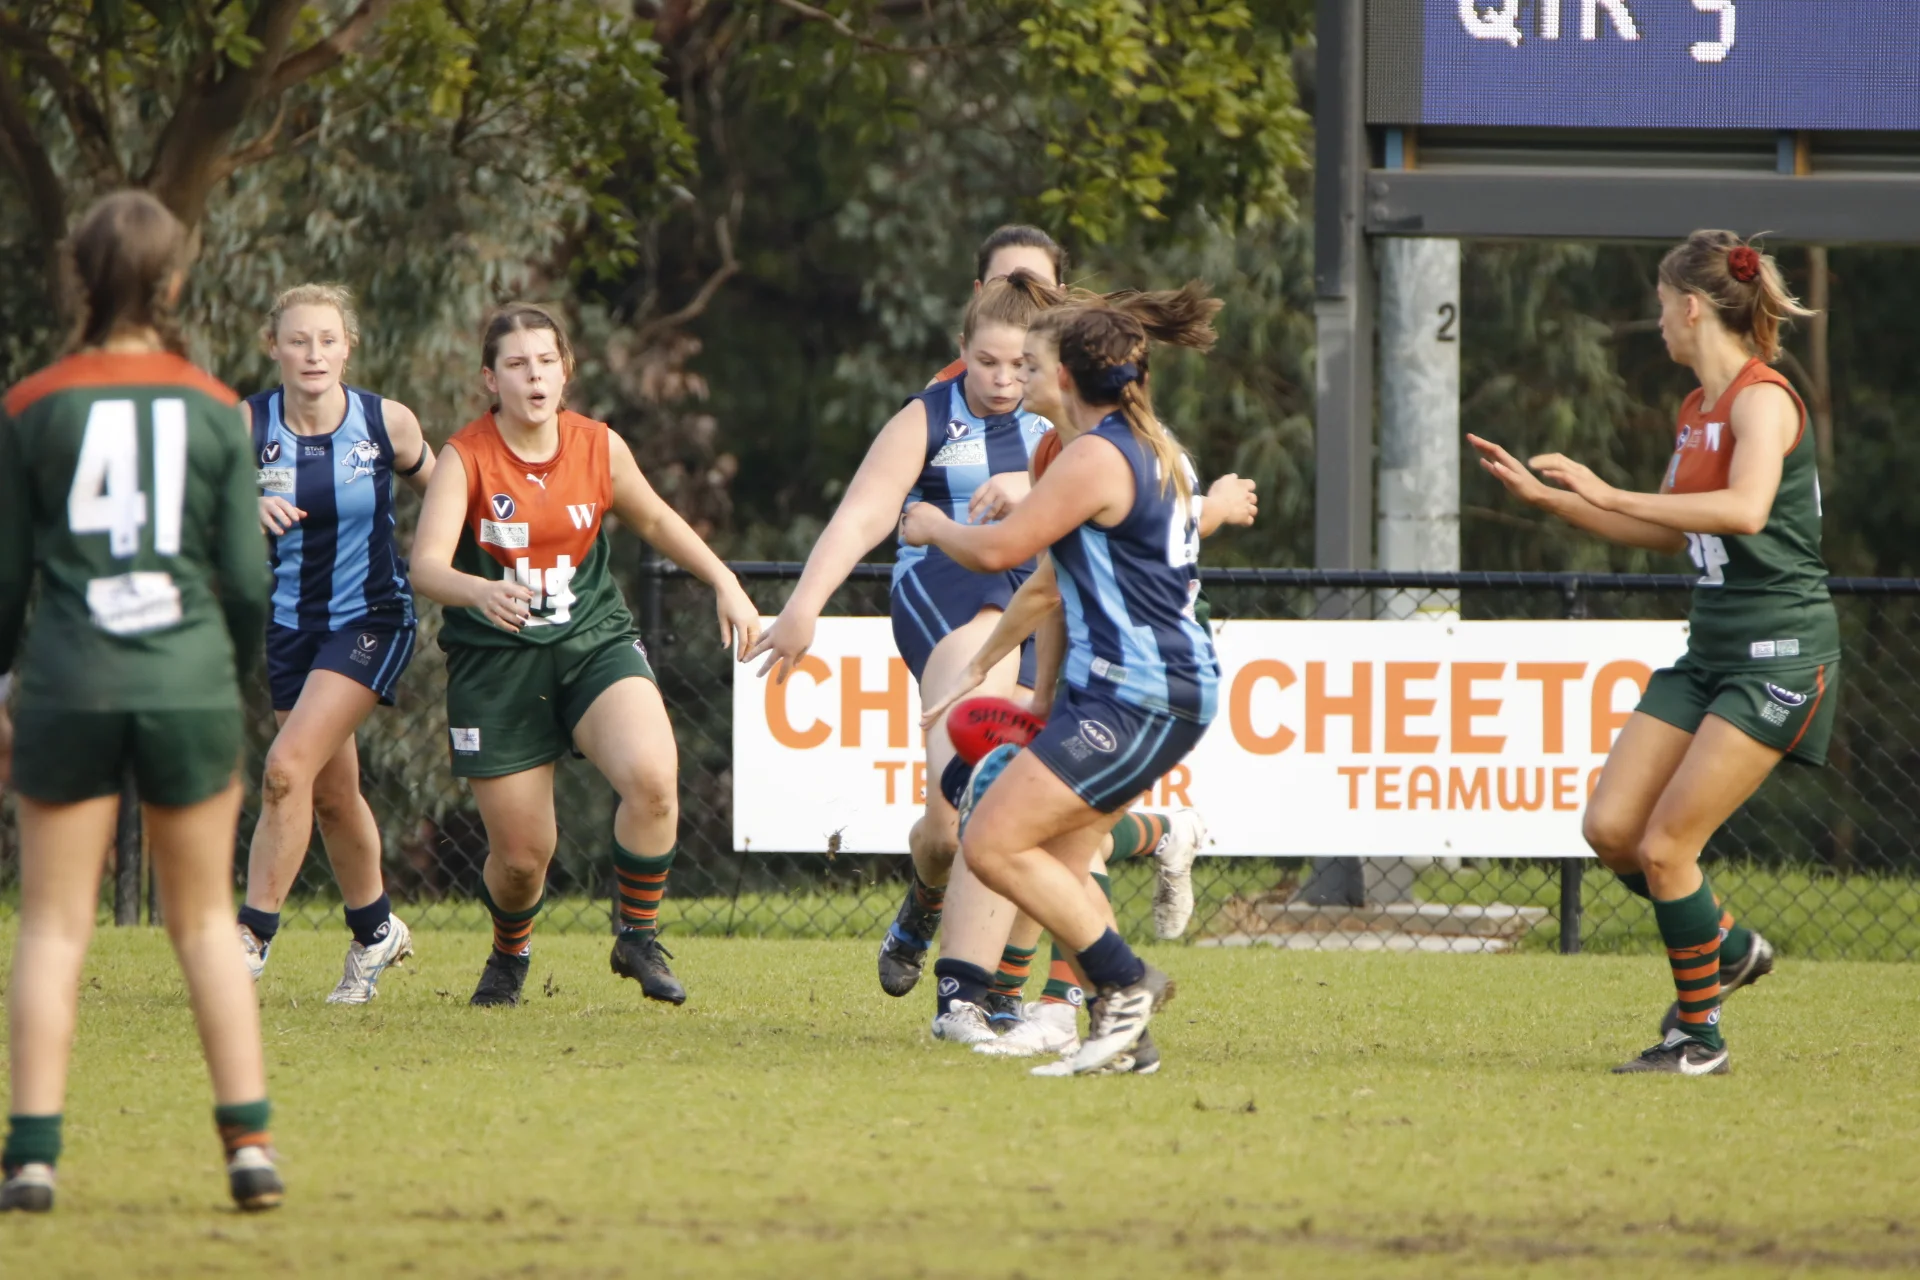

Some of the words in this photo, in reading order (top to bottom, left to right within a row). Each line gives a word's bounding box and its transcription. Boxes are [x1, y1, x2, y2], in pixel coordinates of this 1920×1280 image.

[1437, 302, 1456, 342] 2
[67, 397, 188, 559] 41
[566, 502, 597, 530] W
[1084, 723, 1112, 750] VAFA
